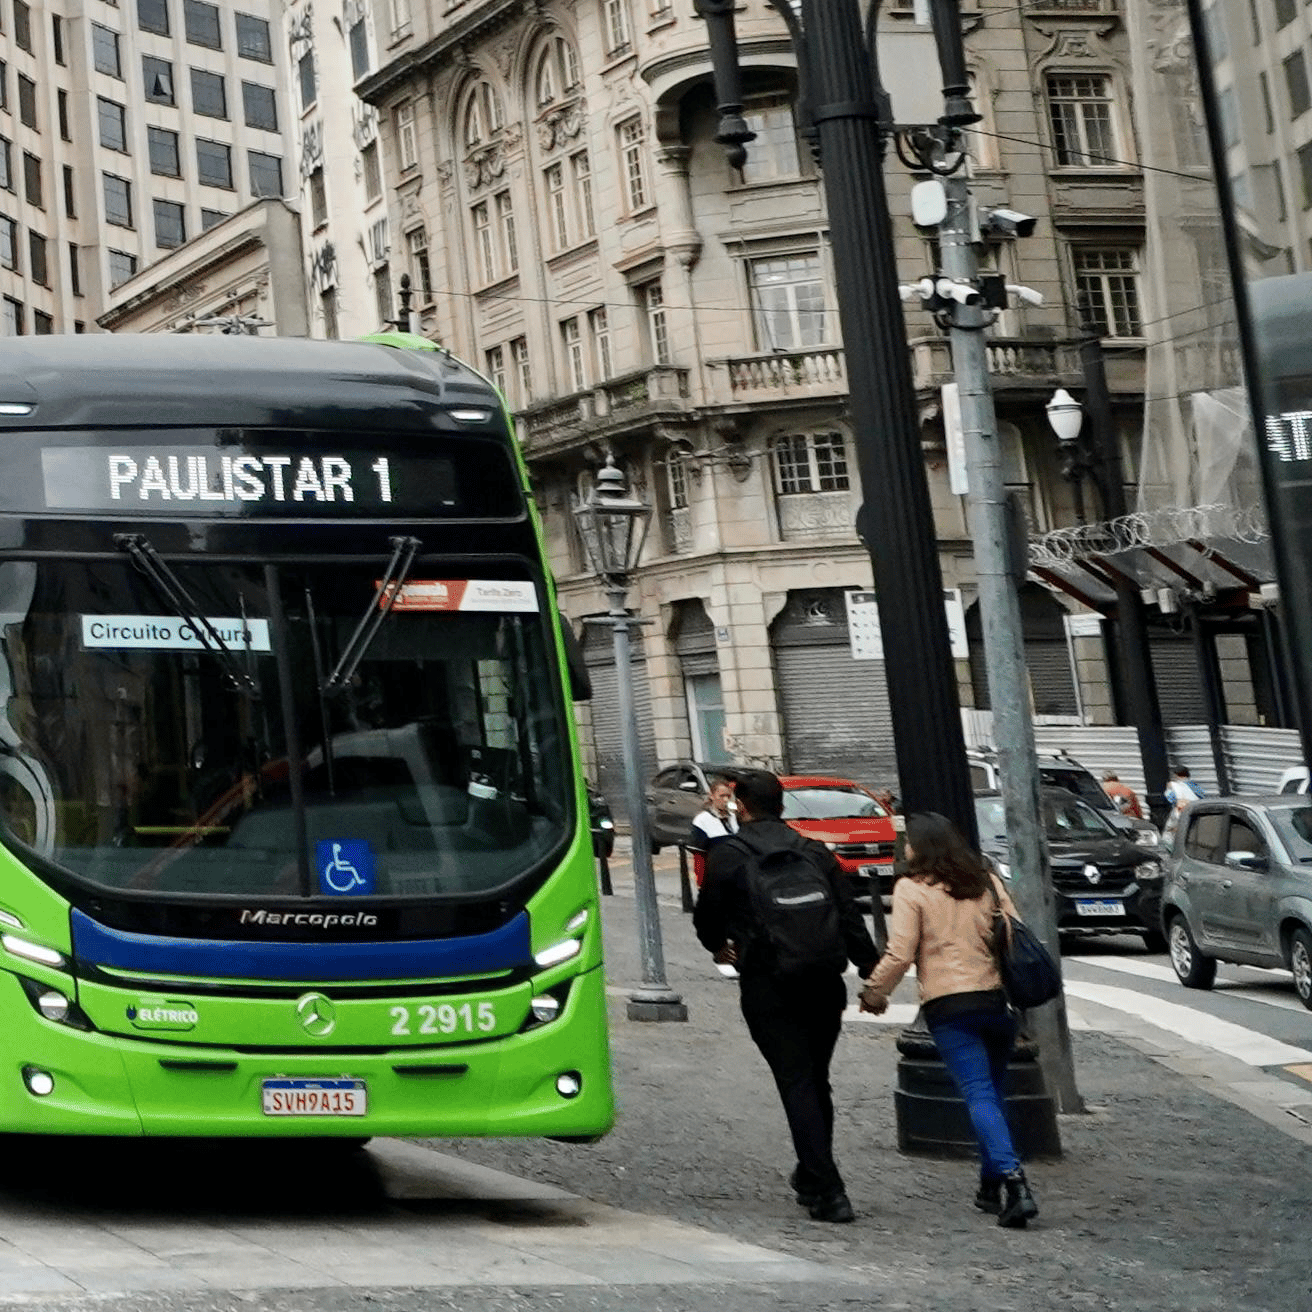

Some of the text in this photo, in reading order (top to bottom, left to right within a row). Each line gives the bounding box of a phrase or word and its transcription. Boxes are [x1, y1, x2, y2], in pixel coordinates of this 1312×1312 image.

[108, 455, 392, 502] PAULISTAR 1
[90, 623, 172, 640] Circuito
[240, 909, 377, 929] Marcopolo
[139, 1007, 198, 1024] ELÉTRICO
[390, 1002, 496, 1036] 2 2915
[272, 1091, 355, 1113] SVH9A15
